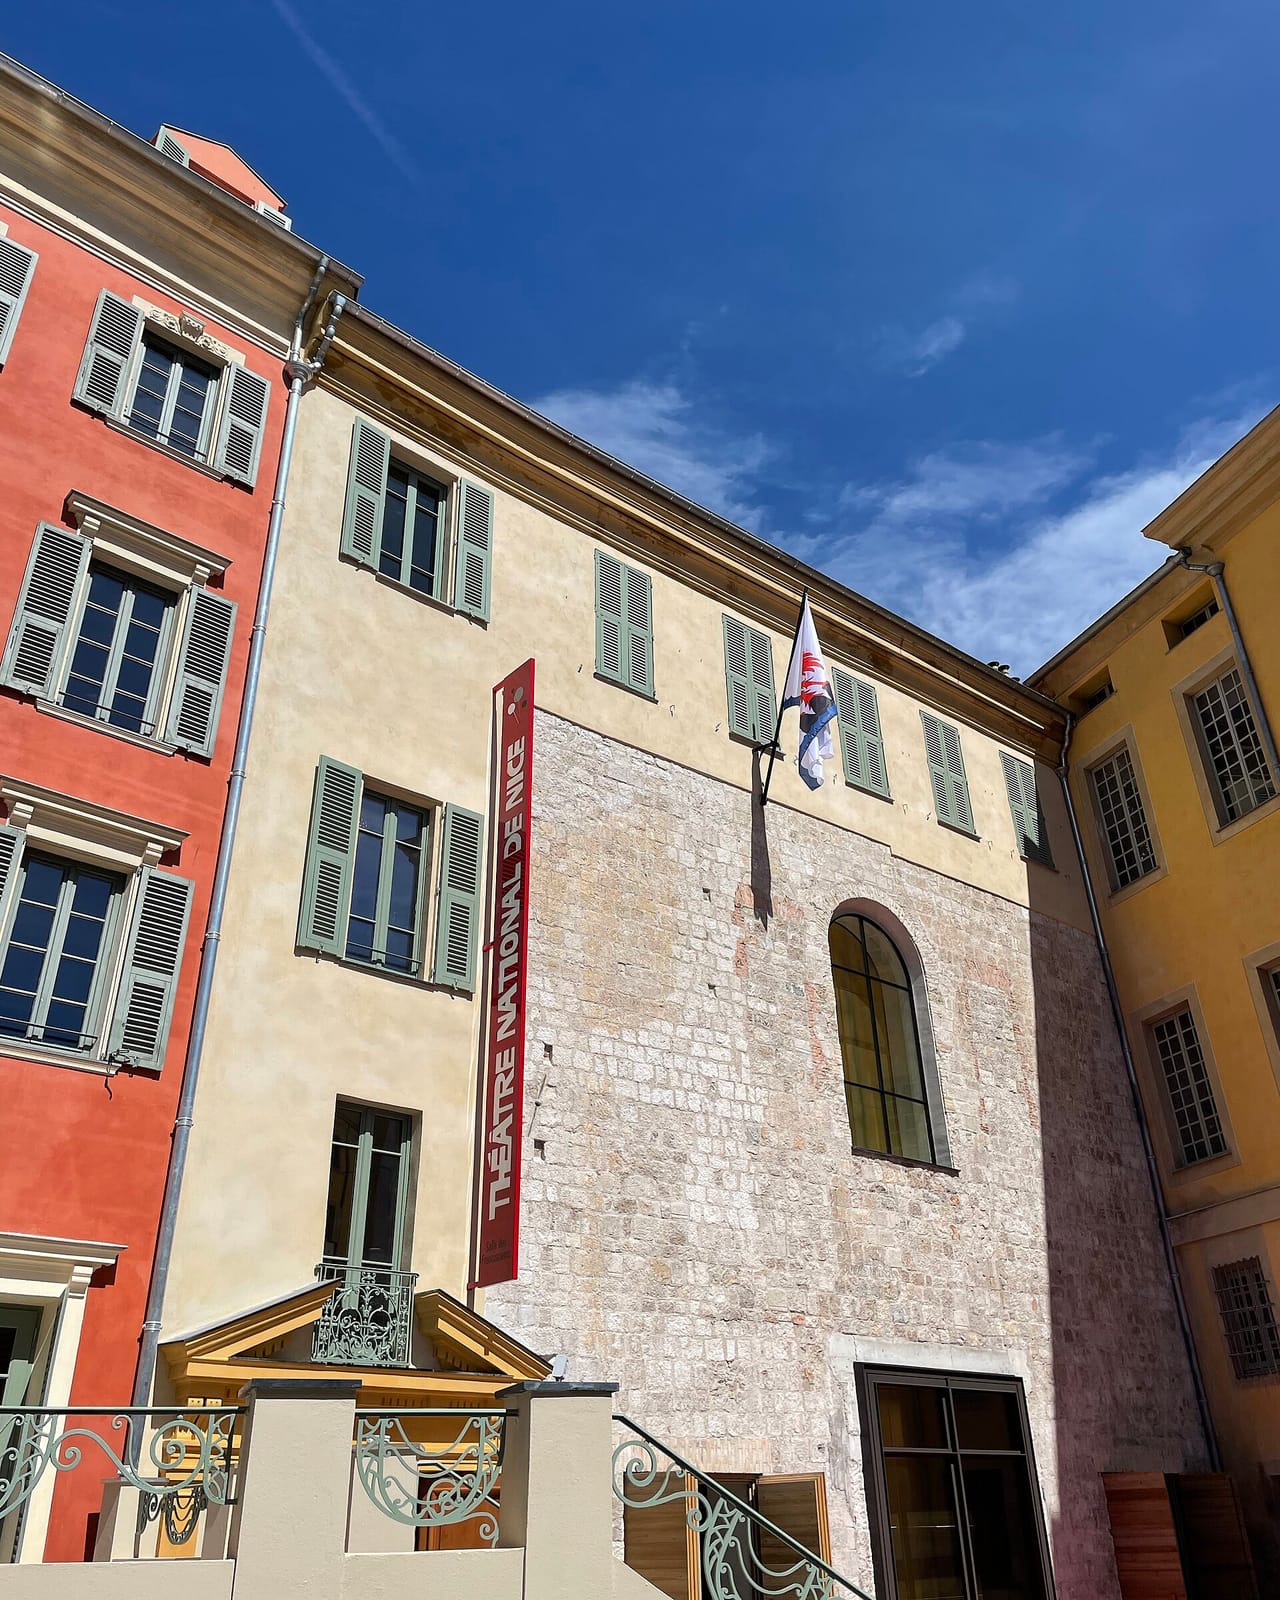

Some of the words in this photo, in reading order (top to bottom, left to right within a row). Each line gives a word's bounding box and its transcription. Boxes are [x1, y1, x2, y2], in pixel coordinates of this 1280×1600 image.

[504, 812, 523, 860] DE
[506, 735, 526, 812] NICE
[497, 861, 522, 1042] NATIONAL
[488, 1046, 515, 1221] THÉÂTRE
